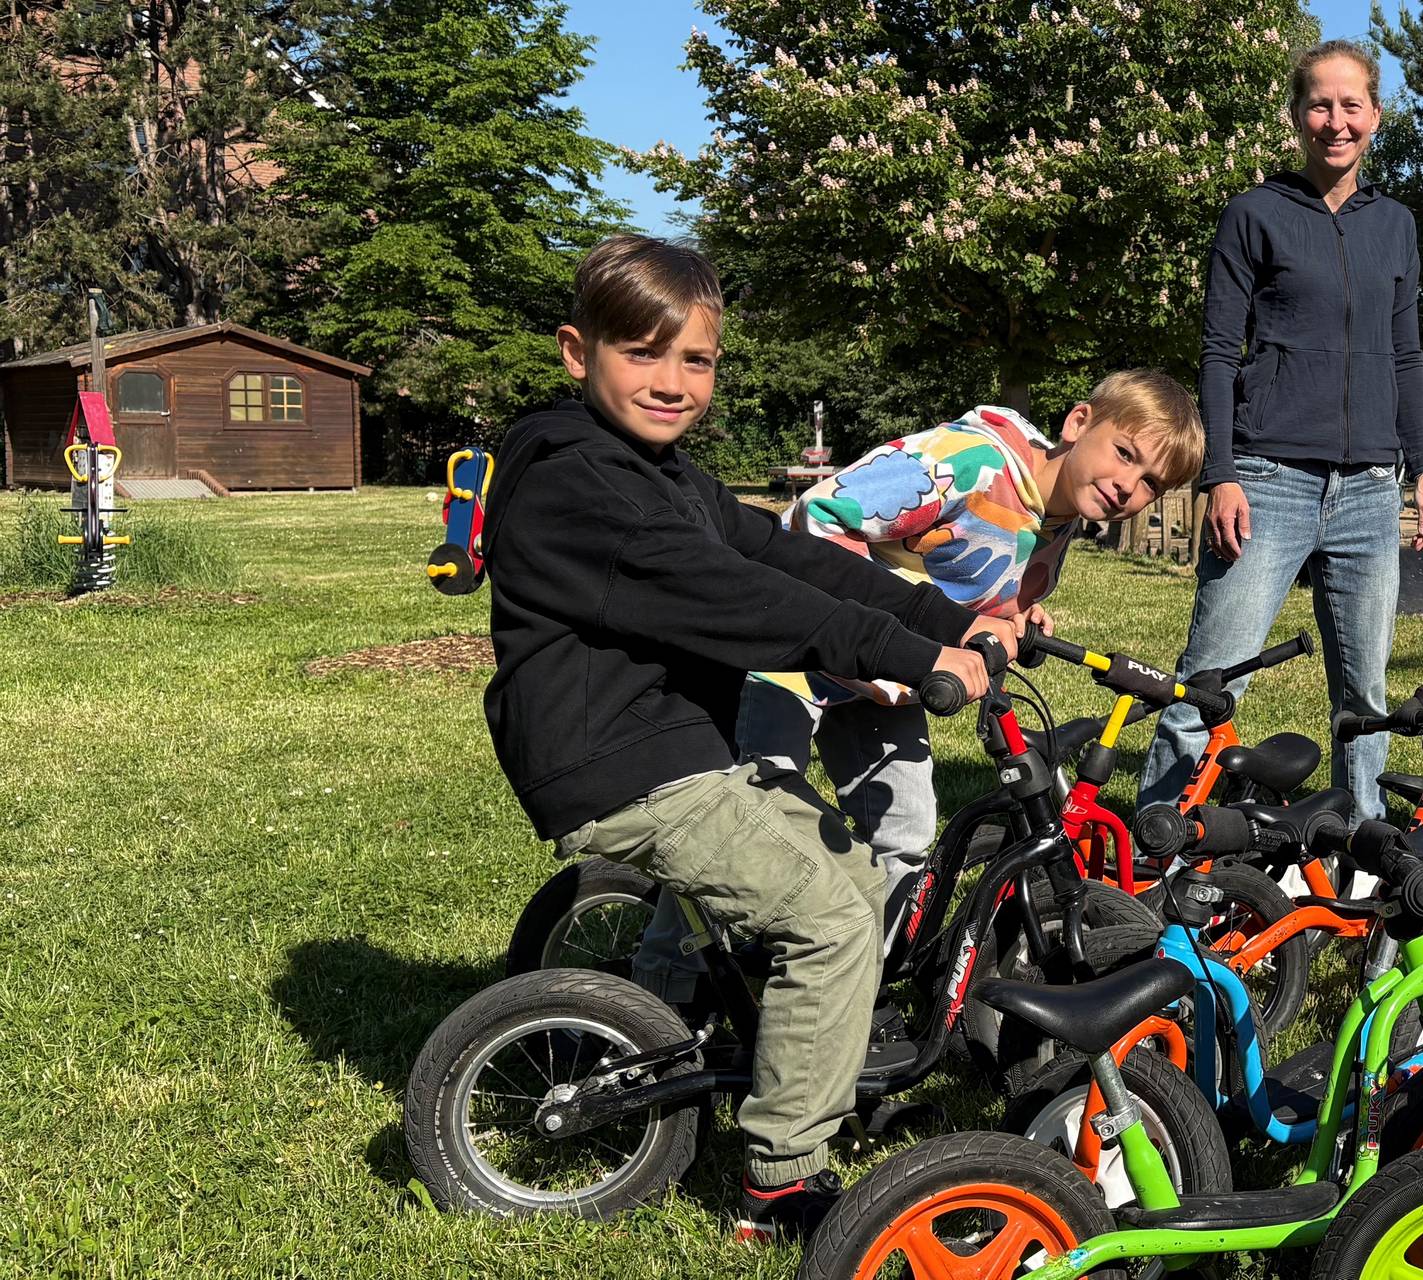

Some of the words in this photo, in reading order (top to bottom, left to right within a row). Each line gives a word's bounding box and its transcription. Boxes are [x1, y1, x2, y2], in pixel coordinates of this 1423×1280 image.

[1127, 660, 1168, 681] PUKY
[947, 928, 975, 1001] PUKY
[1366, 1078, 1382, 1150] PUKY
